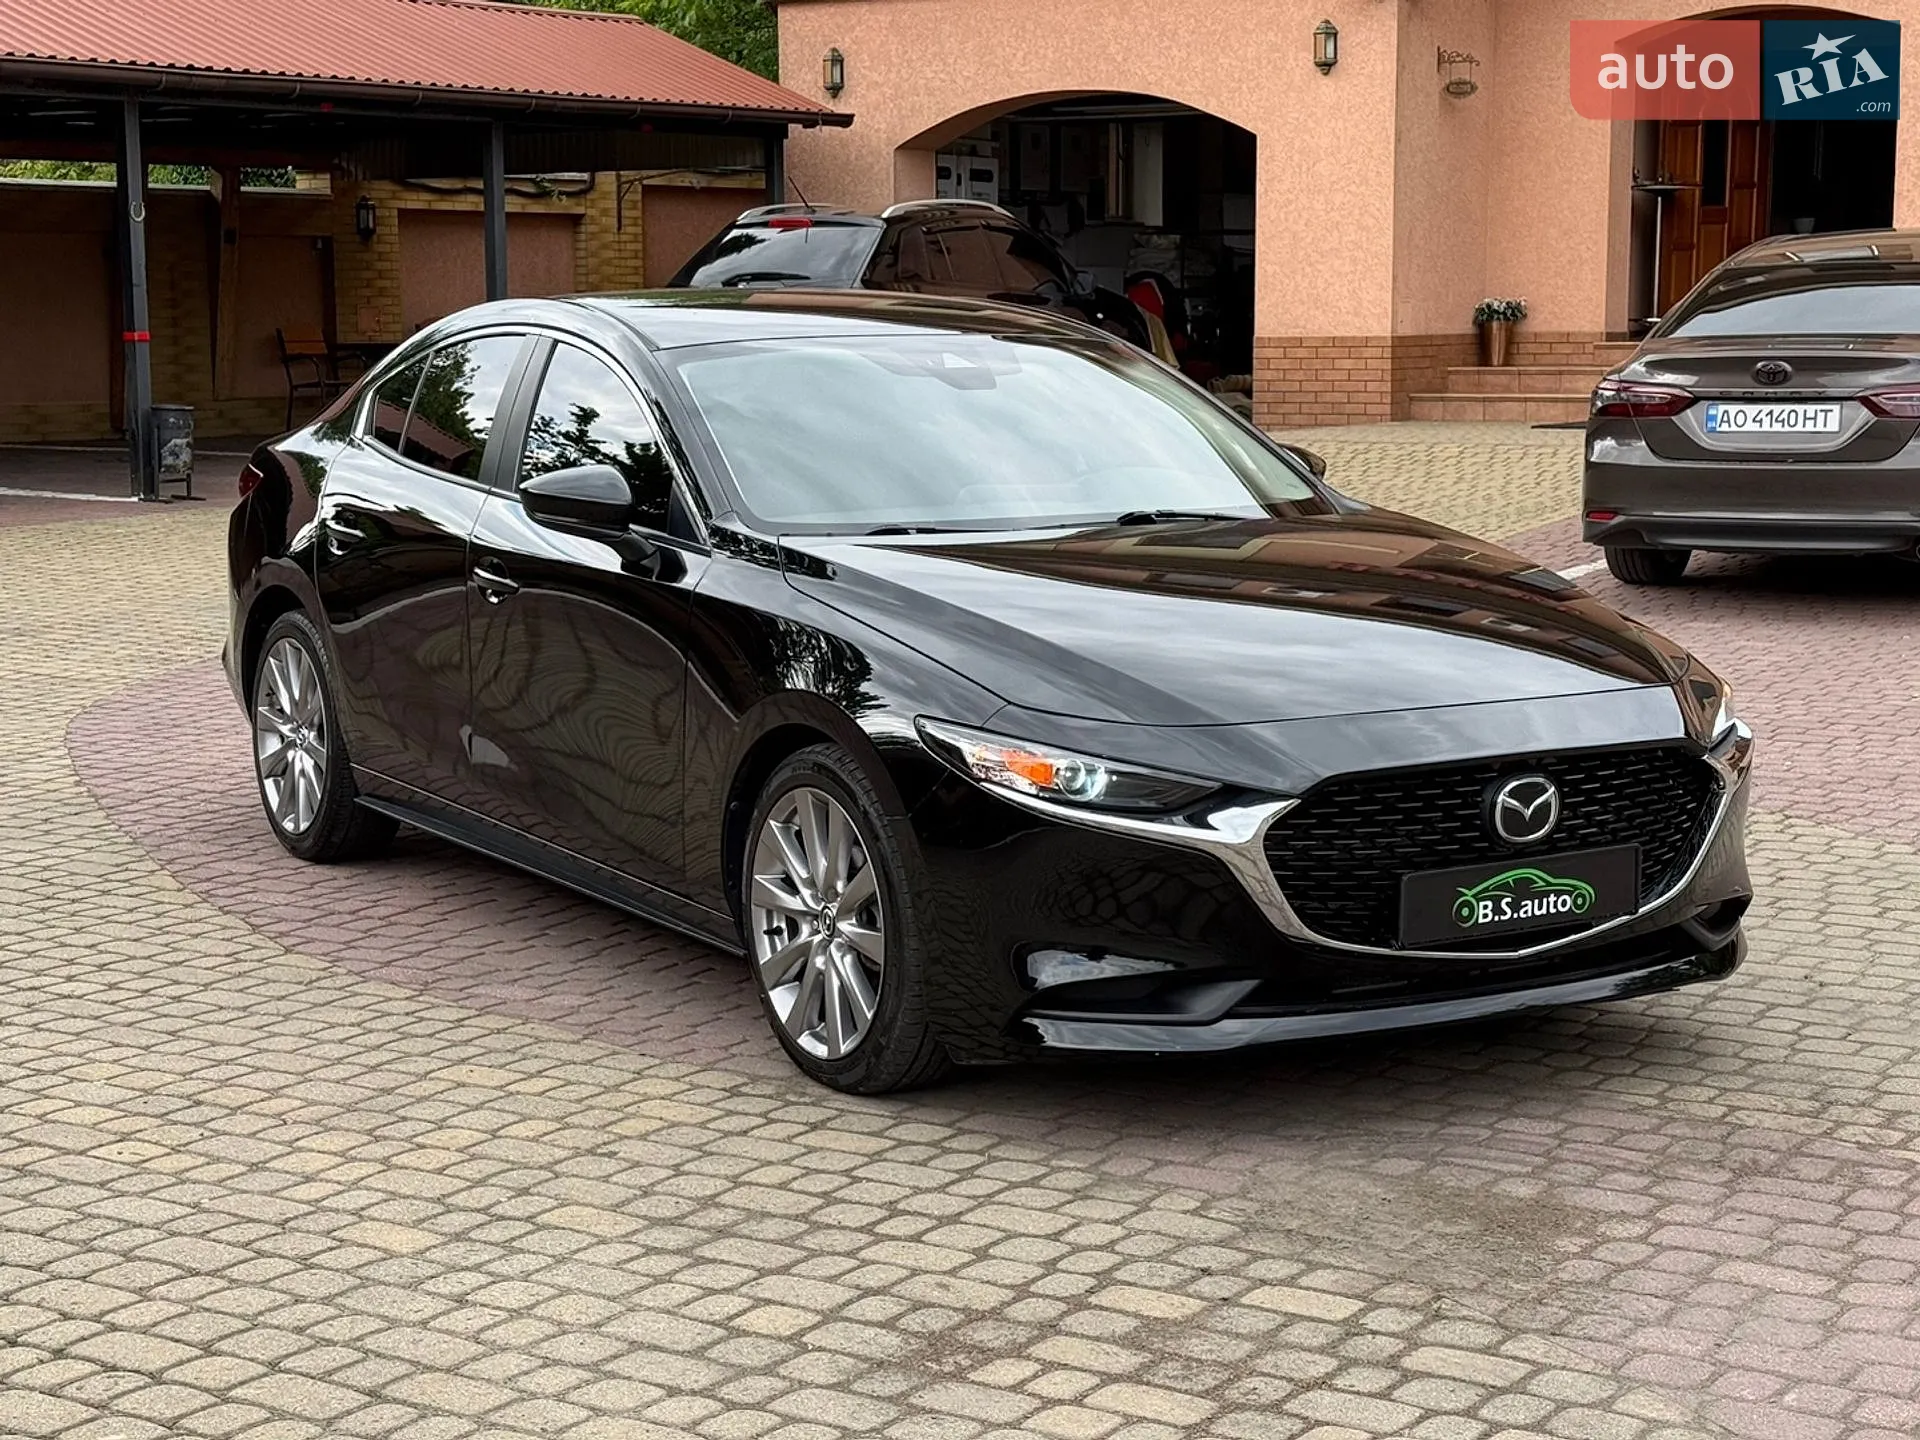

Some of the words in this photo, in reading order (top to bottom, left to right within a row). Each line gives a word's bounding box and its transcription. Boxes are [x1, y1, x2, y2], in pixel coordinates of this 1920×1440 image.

[1718, 409, 1748, 428] AO
[1752, 409, 1799, 428] 4140
[1802, 409, 1834, 428] HT
[1477, 893, 1571, 924] B.S.auto
